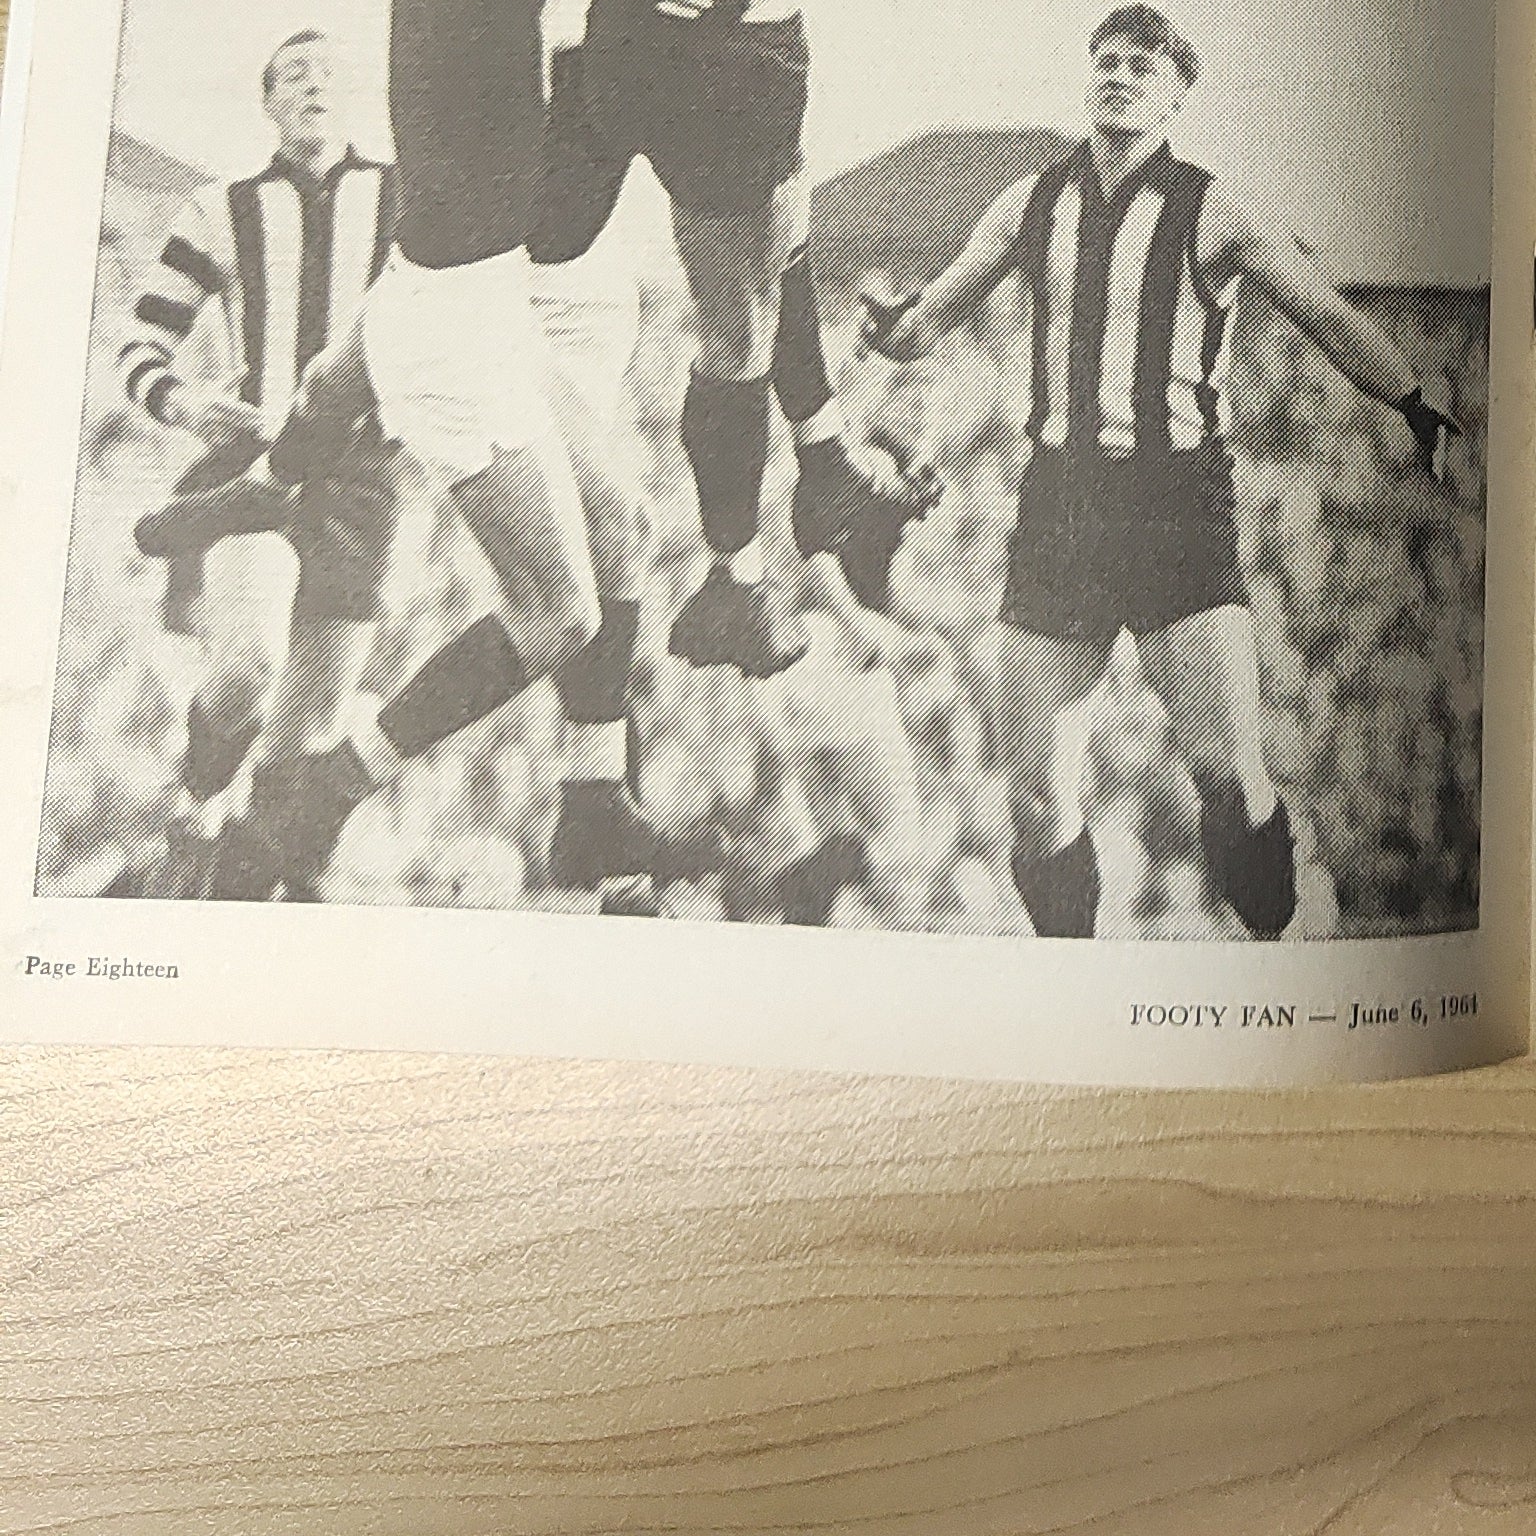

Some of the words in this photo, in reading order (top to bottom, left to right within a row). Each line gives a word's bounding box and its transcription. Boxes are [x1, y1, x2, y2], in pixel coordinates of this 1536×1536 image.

[25, 956, 75, 978] Page
[86, 957, 179, 980] Eighteen
[1131, 1004, 1227, 1027] FOOTY
[1241, 1005, 1296, 1028] FAN
[1348, 1003, 1398, 1028] June
[1411, 998, 1427, 1025] 6,
